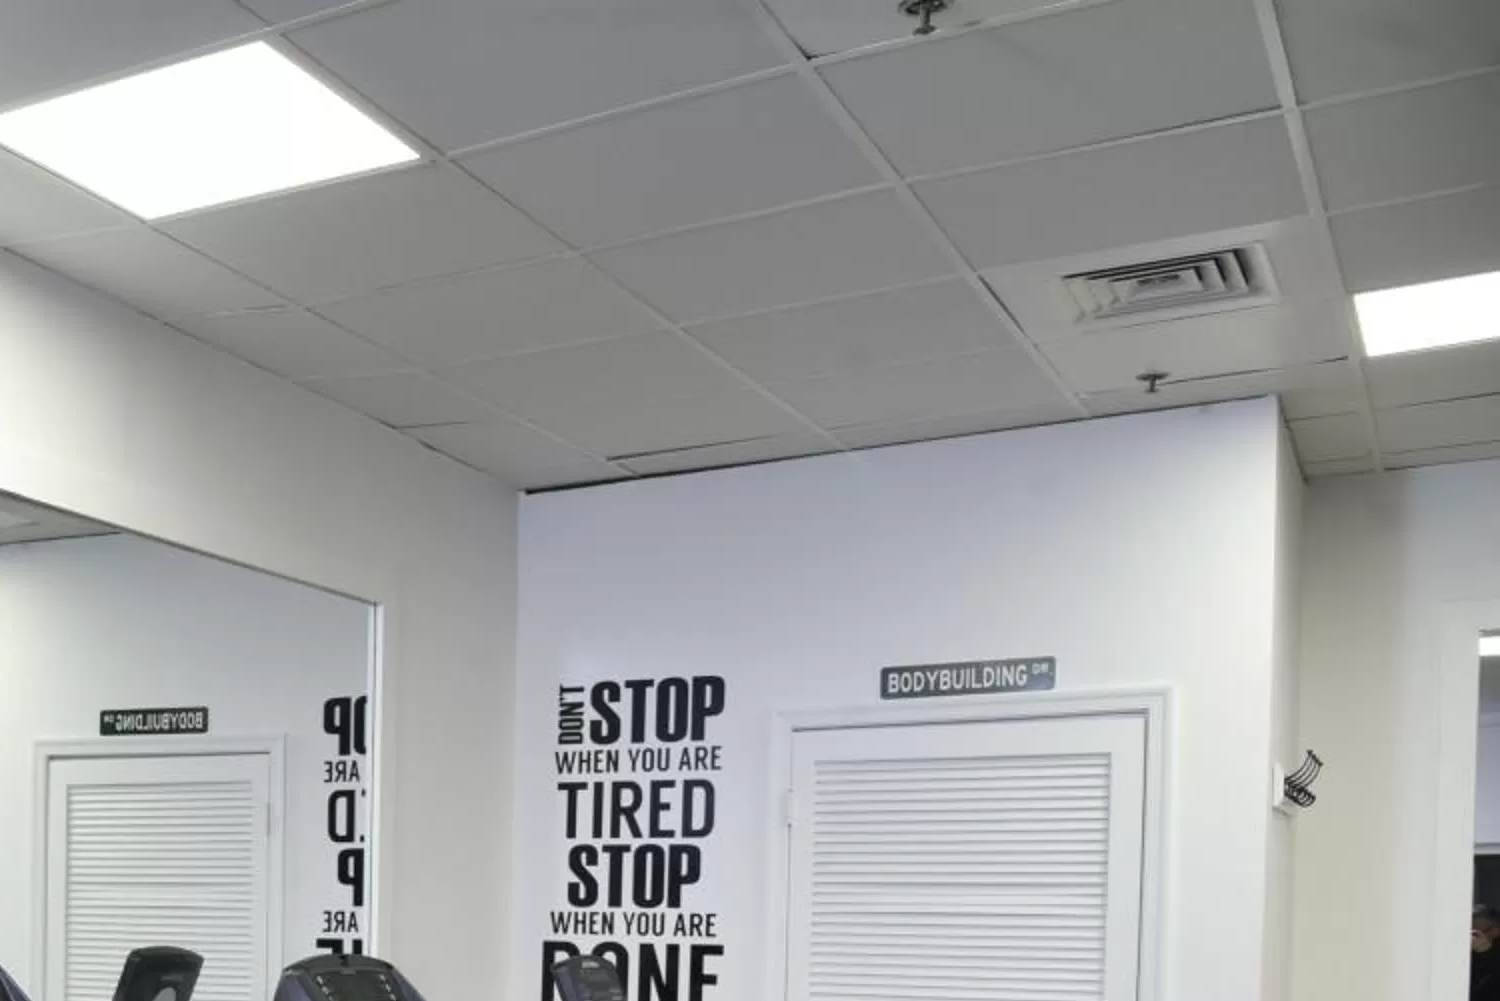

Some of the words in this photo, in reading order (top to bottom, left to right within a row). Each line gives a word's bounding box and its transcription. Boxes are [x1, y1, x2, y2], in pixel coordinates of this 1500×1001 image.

[887, 664, 1028, 694] BODYBUILDING
[558, 683, 585, 745] DON'T
[589, 675, 725, 745] STOP
[555, 749, 619, 774] WHEN
[628, 747, 670, 772] YOU
[678, 746, 722, 771] ARE
[557, 779, 715, 839] TIRED
[567, 843, 701, 908] STOP
[550, 911, 615, 936] WHEN
[623, 912, 665, 937] YOU
[673, 913, 717, 937] ARE
